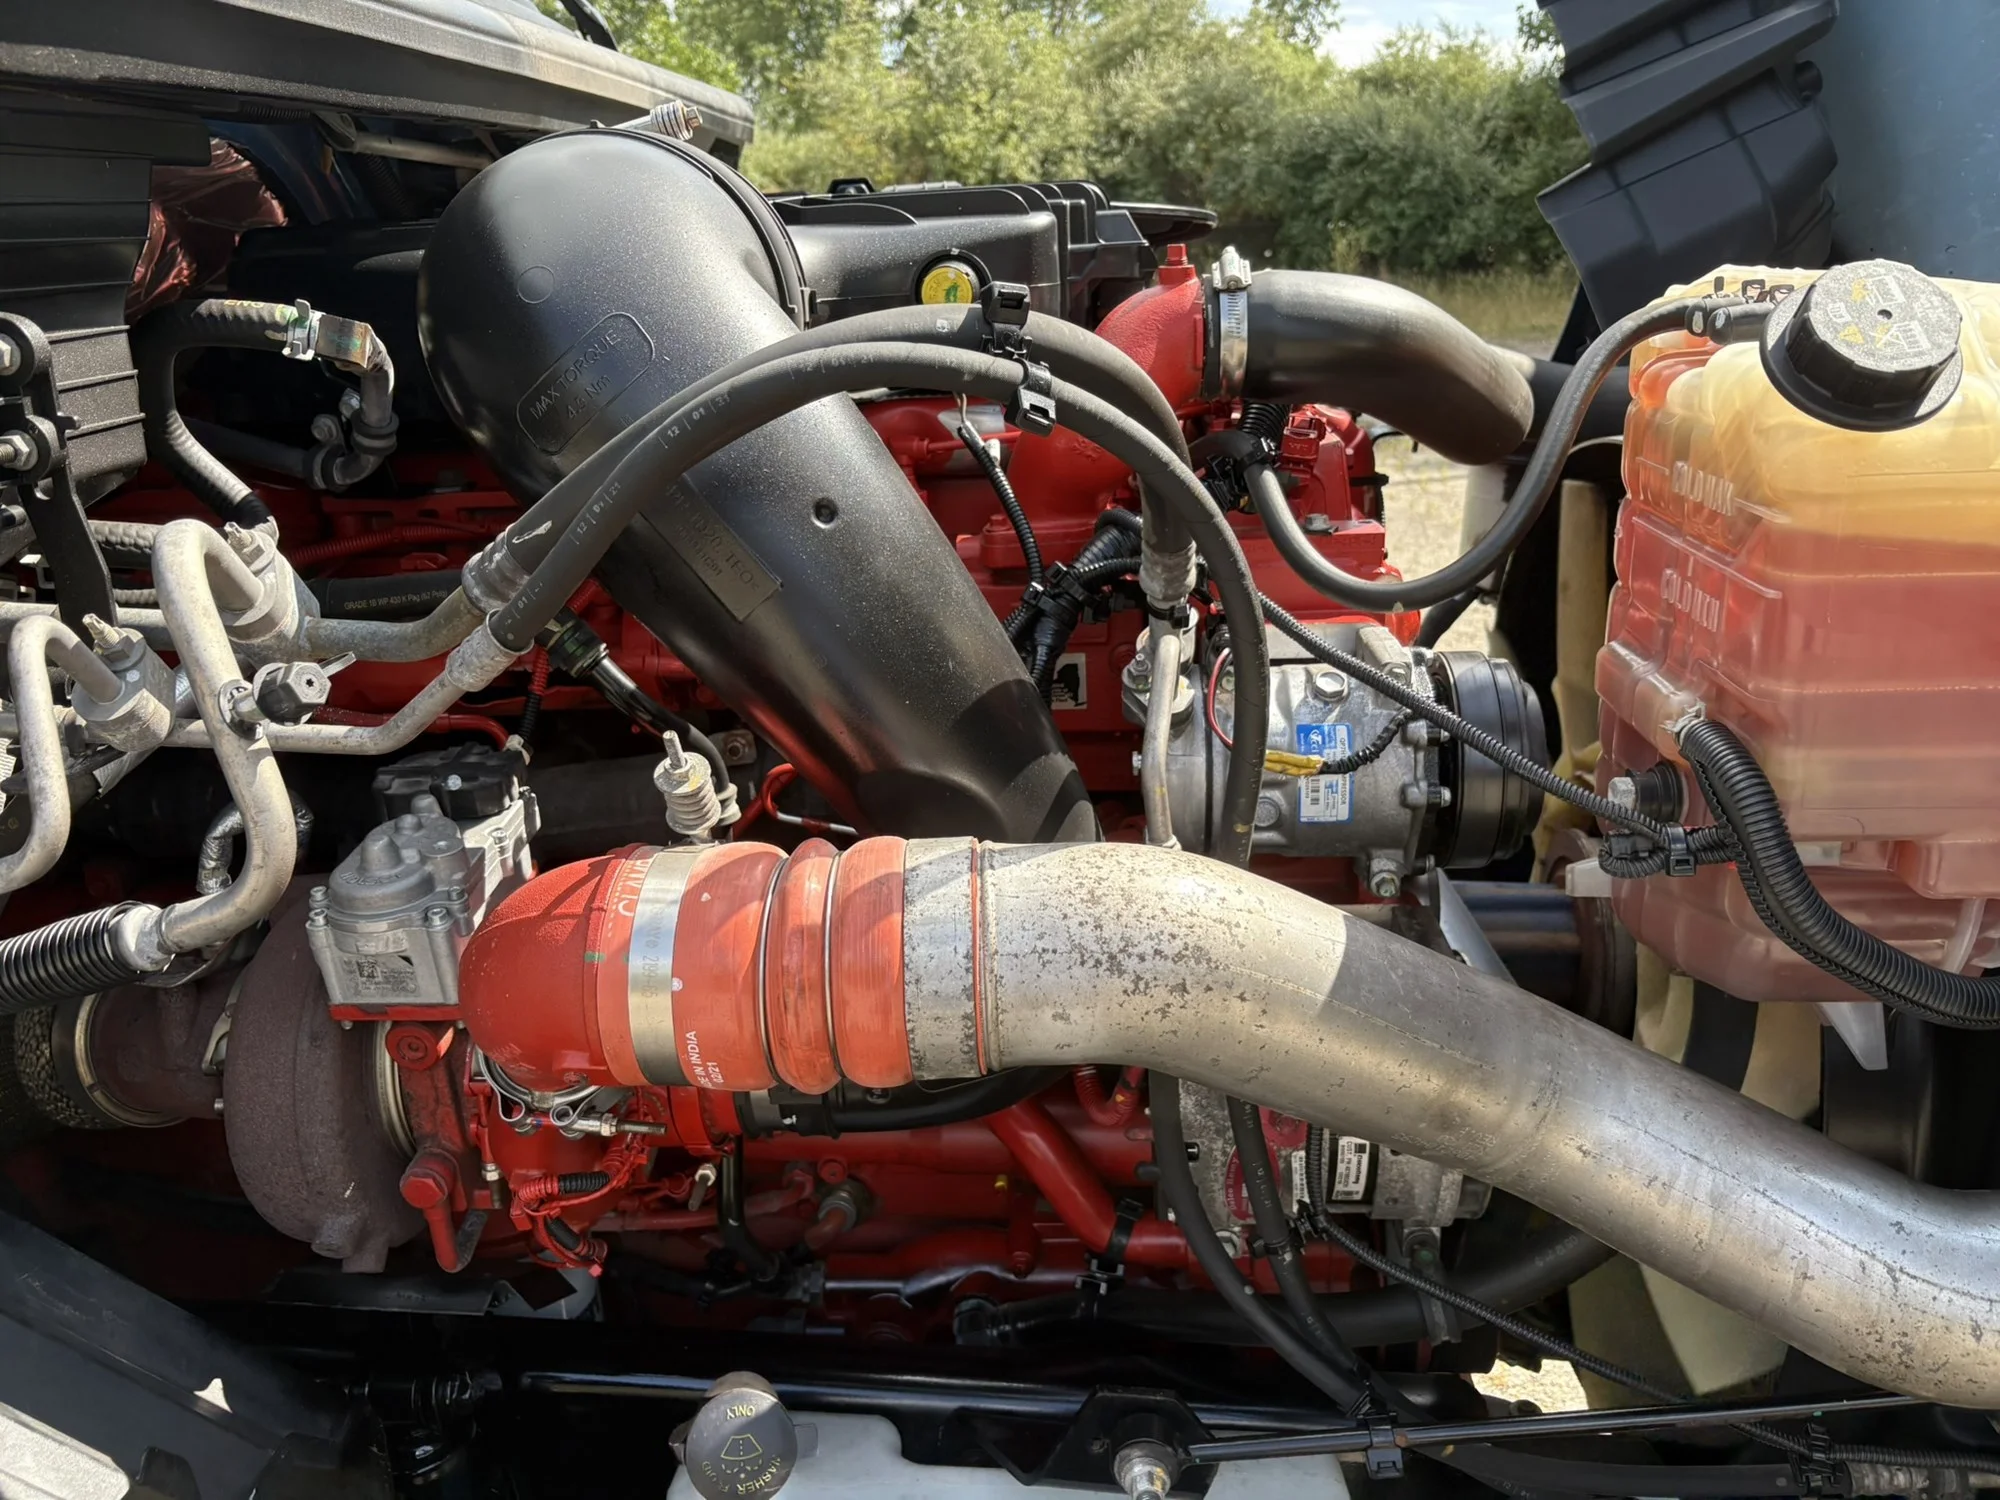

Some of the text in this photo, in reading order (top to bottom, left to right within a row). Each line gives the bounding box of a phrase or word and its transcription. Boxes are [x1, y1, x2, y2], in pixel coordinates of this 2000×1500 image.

[529, 329, 621, 420] MAX TORQUE
[584, 375, 611, 400] Nm
[1704, 473, 1735, 516] MAX
[344, 600, 368, 610] GRADE
[378, 597, 389, 605] WP
[1691, 587, 1720, 633] MIN
[685, 1031, 701, 1063] INDIA
[693, 1066, 705, 1074] IN
[1226, 1157, 1239, 1209] Delco Remy
[726, 1405, 756, 1420] ONLY
